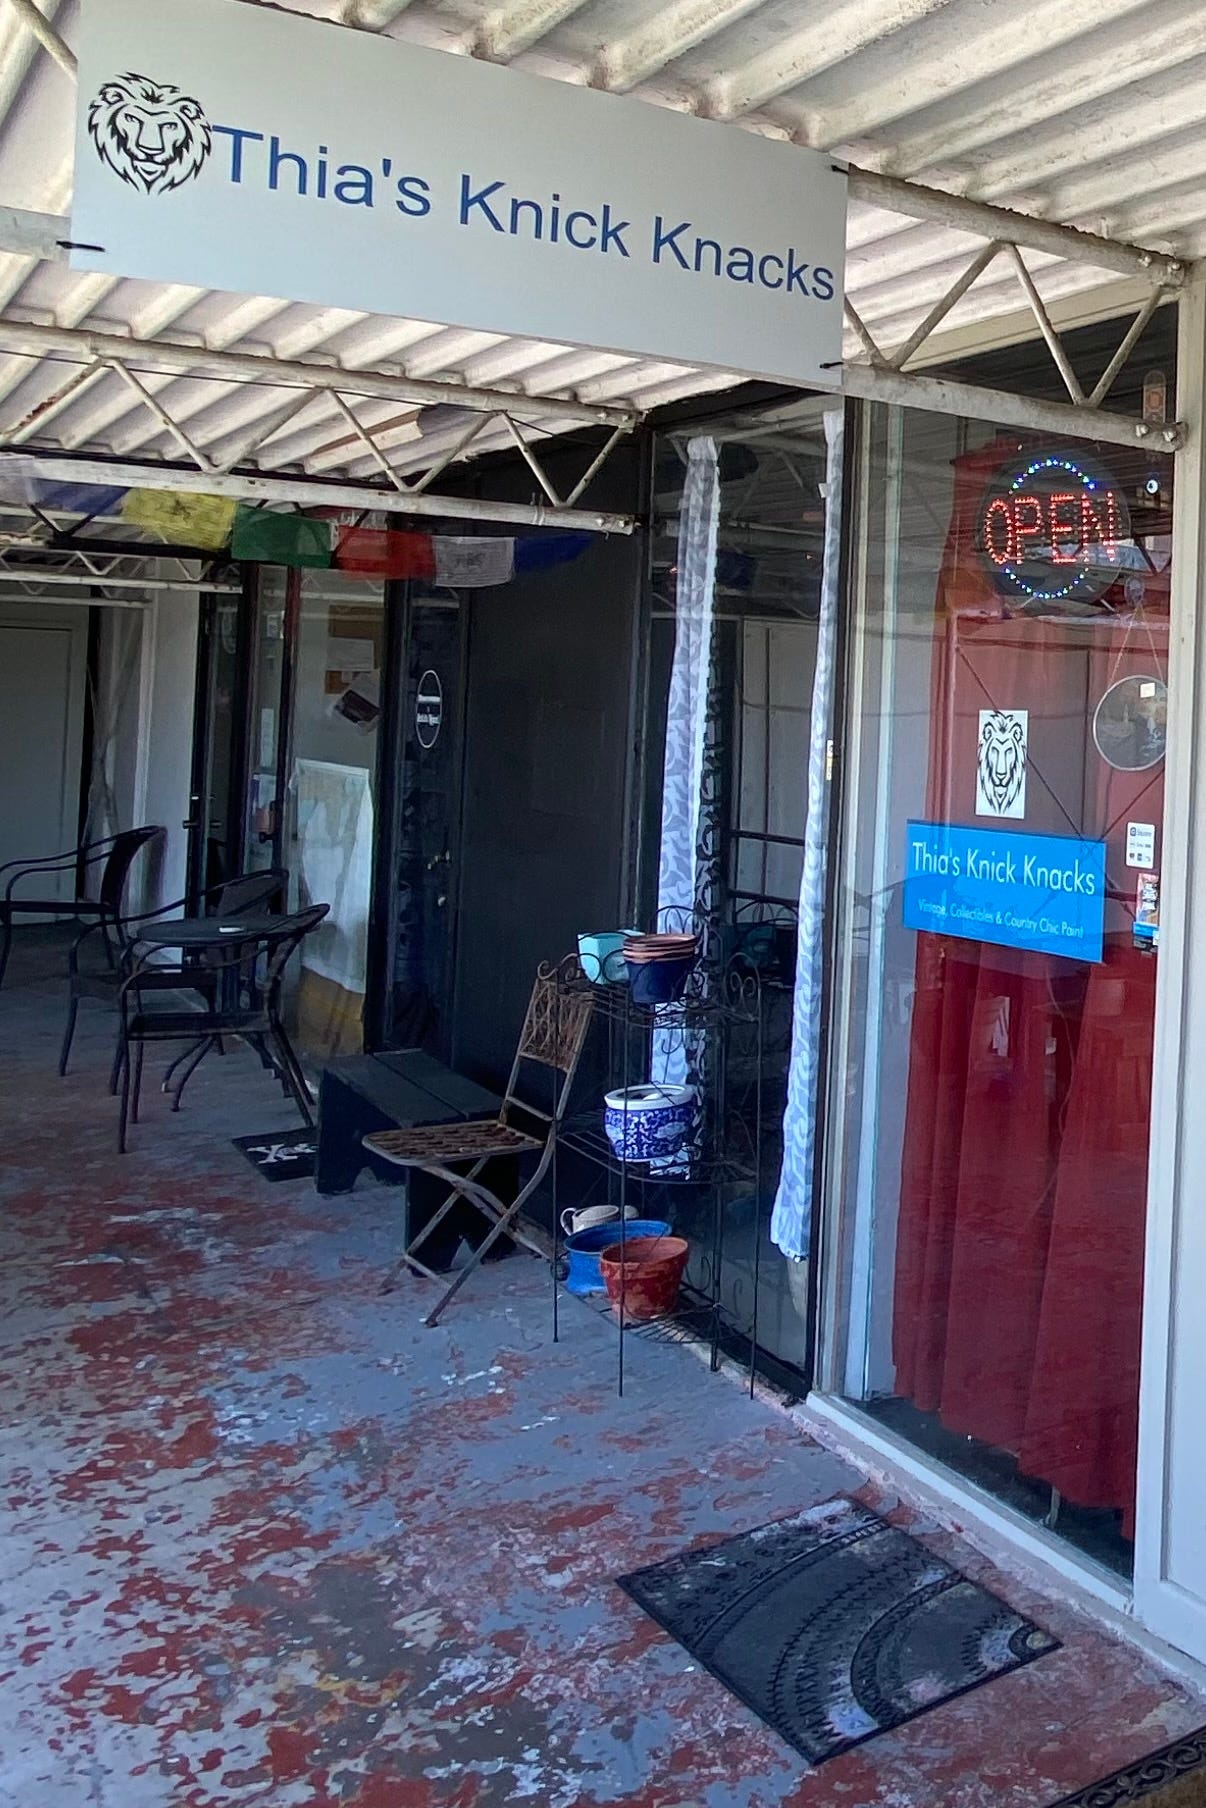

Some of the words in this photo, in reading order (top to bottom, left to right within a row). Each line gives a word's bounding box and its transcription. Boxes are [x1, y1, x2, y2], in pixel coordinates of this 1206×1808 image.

[213, 124, 431, 217] Thia's
[459, 174, 631, 258] Knick
[653, 216, 835, 301] Knacks
[984, 492, 1117, 565] OPEN
[913, 841, 961, 877] Thia's
[966, 848, 1016, 884] Knick
[1024, 854, 1096, 895] Knacks
[951, 904, 994, 923] Collectibles
[995, 912, 1003, 925] &
[1004, 911, 1038, 934] Country
[1039, 918, 1059, 936] Chic
[1061, 921, 1085, 939] Paint
